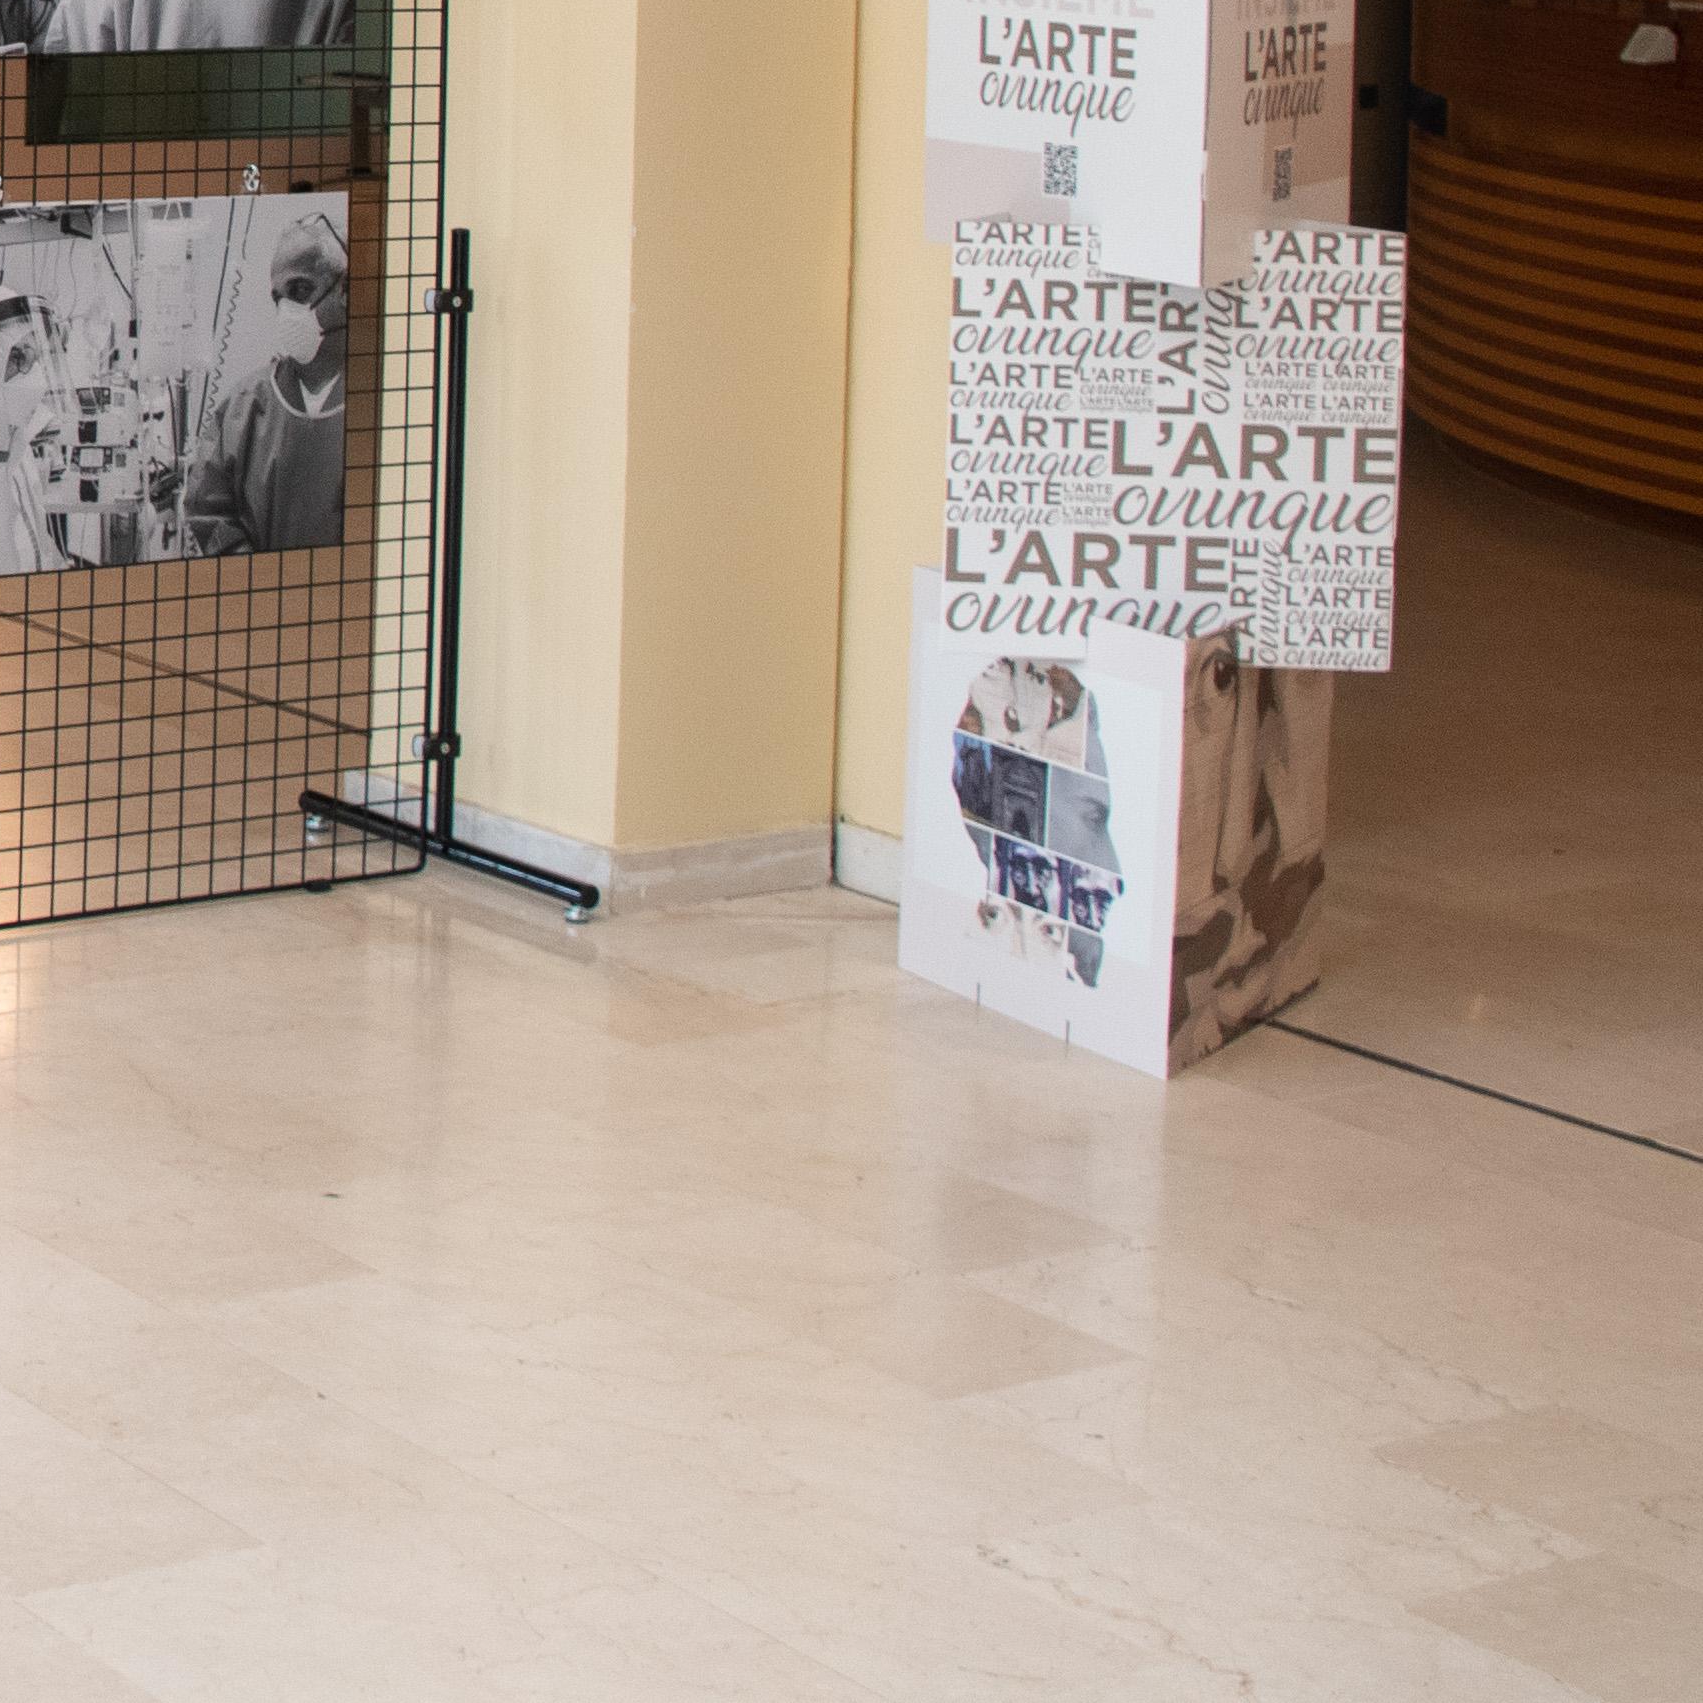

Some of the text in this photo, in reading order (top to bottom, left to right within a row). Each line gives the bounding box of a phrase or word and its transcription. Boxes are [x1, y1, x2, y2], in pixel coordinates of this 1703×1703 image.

[979, 15, 1137, 80] L'ARTE
[1244, 22, 1327, 82] L'ARTE
[980, 70, 1135, 138] ovunque
[955, 246, 1081, 279] ovunque
[1253, 230, 1404, 266] 'ARTE
[952, 277, 1157, 323] L'ARTE
[1233, 296, 1403, 333] L'ARTE
[952, 323, 1156, 374] ovunque
[1235, 333, 1401, 375] ovunque
[950, 361, 1074, 389] L'ARTE
[1080, 367, 1154, 385] L'ARTE
[1245, 362, 1318, 378] L'ARTE
[950, 388, 1074, 418] ovunque
[1244, 393, 1394, 412] L'ARTE L'ARTE
[950, 413, 1109, 449] L'ARTE
[951, 449, 1108, 487] ovunque
[1112, 419, 1399, 484] L'ARTE
[946, 478, 1062, 505] L'ARTE
[1113, 484, 1393, 557] ovunque
[945, 527, 1230, 592] L'ARTE
[1287, 544, 1394, 567] L'ARTE
[1230, 538, 1259, 664] LARTE
[1285, 586, 1392, 610] L'ARTE
[1284, 627, 1390, 651] L'ARTE
